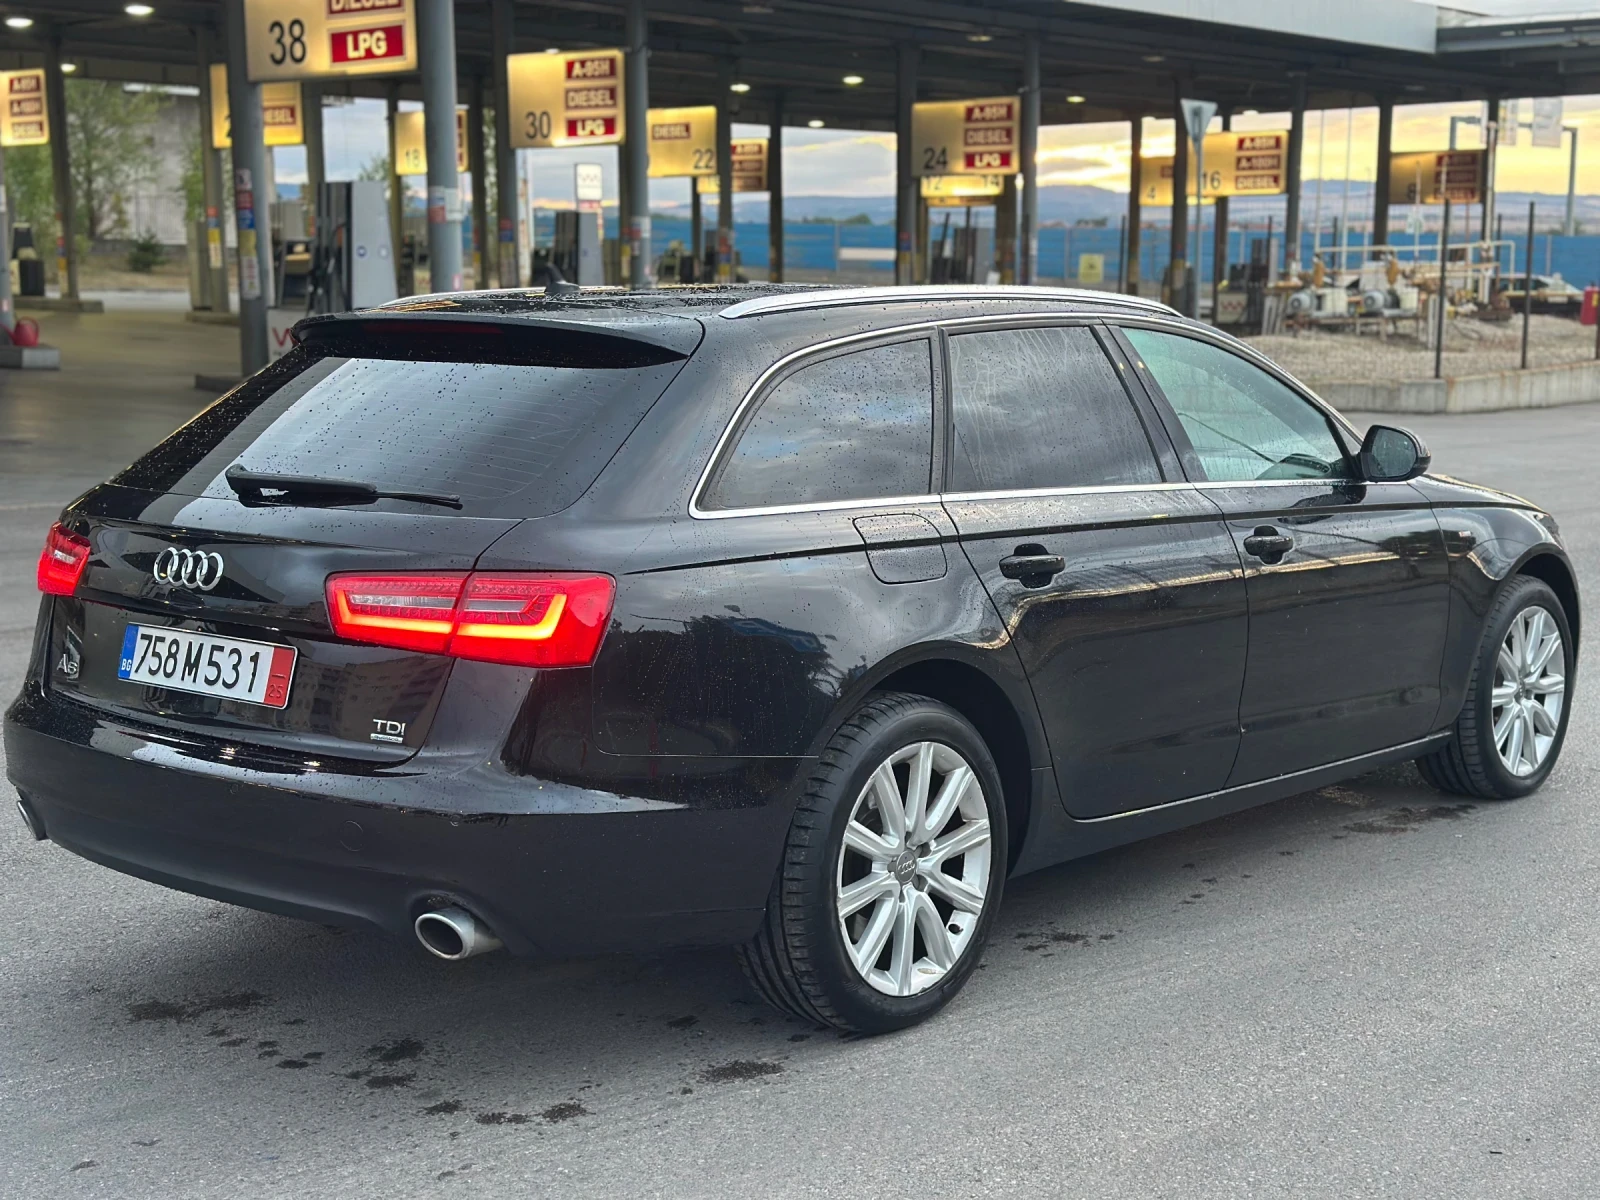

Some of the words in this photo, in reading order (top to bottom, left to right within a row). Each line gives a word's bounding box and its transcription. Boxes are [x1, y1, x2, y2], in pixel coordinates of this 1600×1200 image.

[269, 19, 306, 65] 38
[346, 30, 388, 59] LPG
[567, 89, 614, 107] DIESEL
[525, 111, 551, 139] 30
[577, 119, 606, 136] LPG
[652, 125, 688, 139] DIESEL
[966, 128, 1010, 144] DIESEL
[693, 149, 714, 170] 22
[923, 147, 948, 170] 24
[974, 152, 1001, 168] LPG
[1202, 171, 1221, 190] 16
[1236, 175, 1277, 189] DIESEL
[57, 654, 78, 674] A6
[121, 659, 132, 671] BG
[268, 684, 284, 698] 25
[373, 719, 406, 735] TDI
